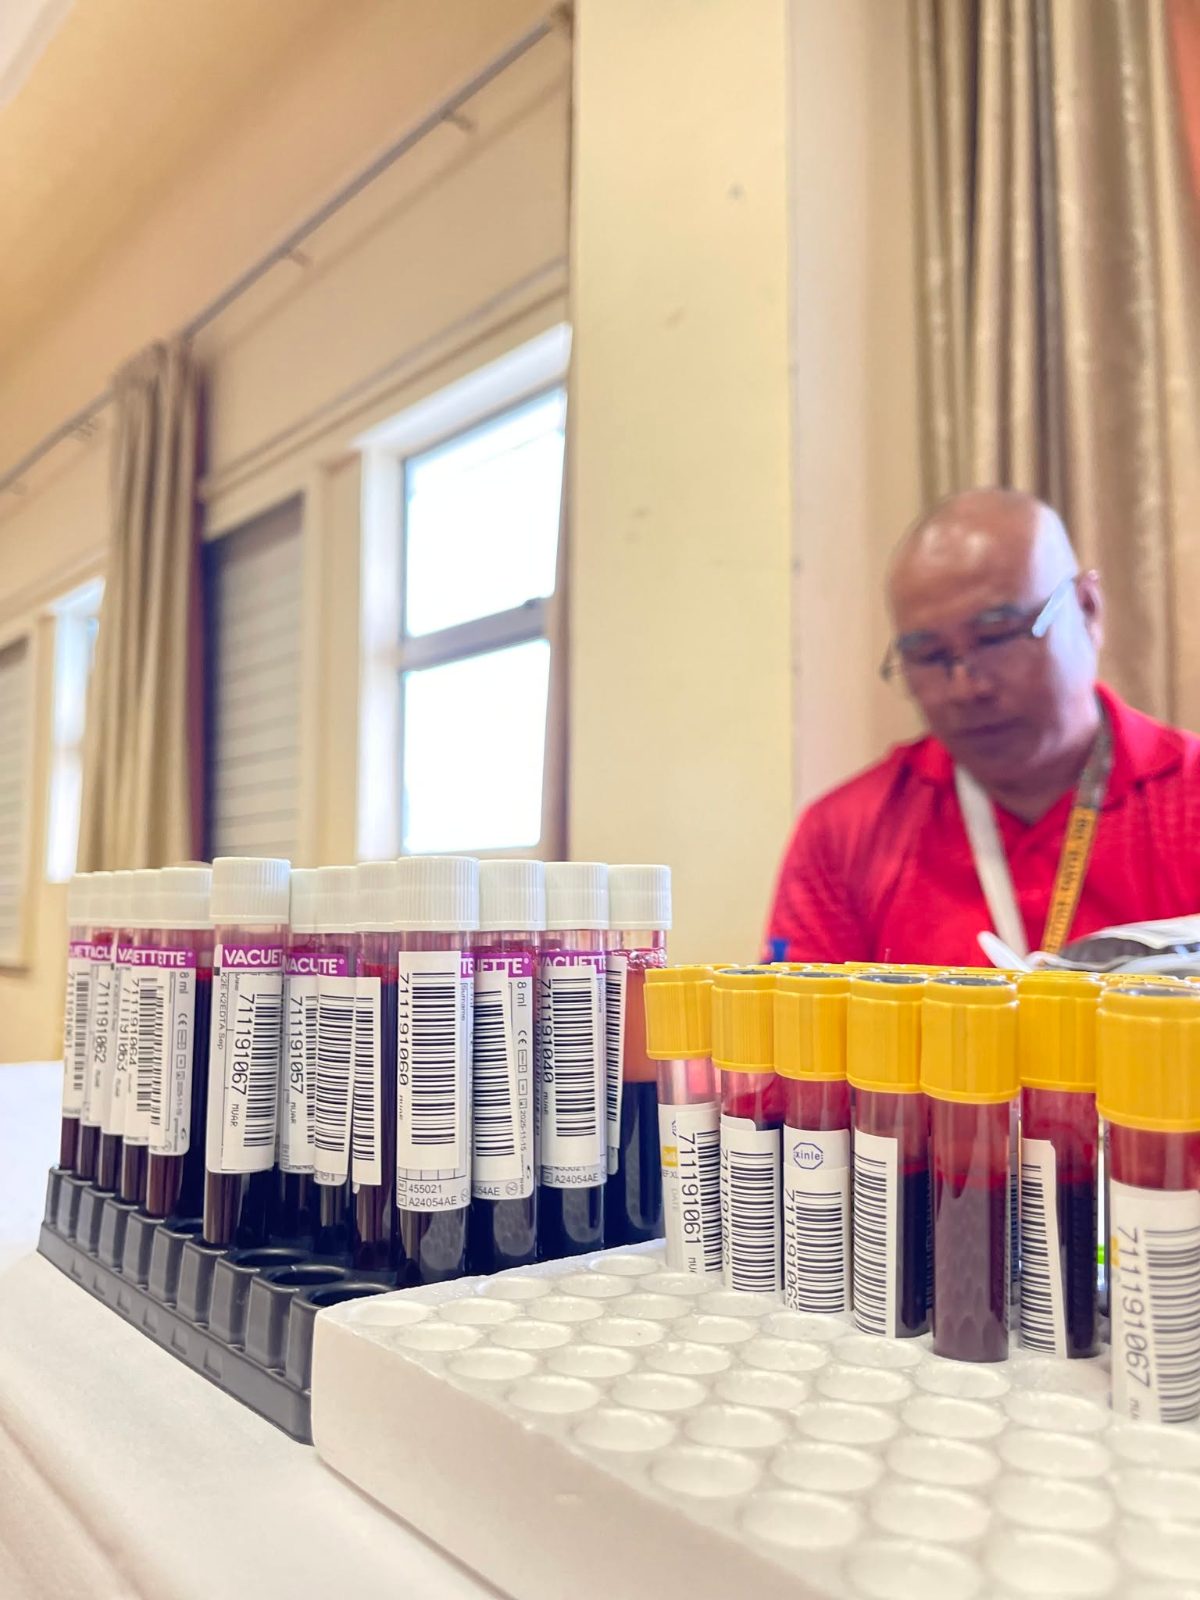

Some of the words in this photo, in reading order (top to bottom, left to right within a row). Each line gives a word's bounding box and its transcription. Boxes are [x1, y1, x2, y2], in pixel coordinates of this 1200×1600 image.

[95, 981, 110, 1063] 711191062
[517, 981, 527, 989] 8
[517, 992, 527, 1007] ml
[231, 993, 255, 1096] 711191067
[290, 996, 304, 1095] 711191057
[399, 972, 410, 1086] 711191060
[541, 979, 554, 1084] 711191040
[231, 1103, 239, 1128] MUAR
[408, 1184, 443, 1194] 455021
[408, 1195, 457, 1208] A24054AE
[554, 1173, 599, 1184] A24054AE
[678, 1133, 701, 1244] 711191061
[1116, 1226, 1152, 1388] 711191067
